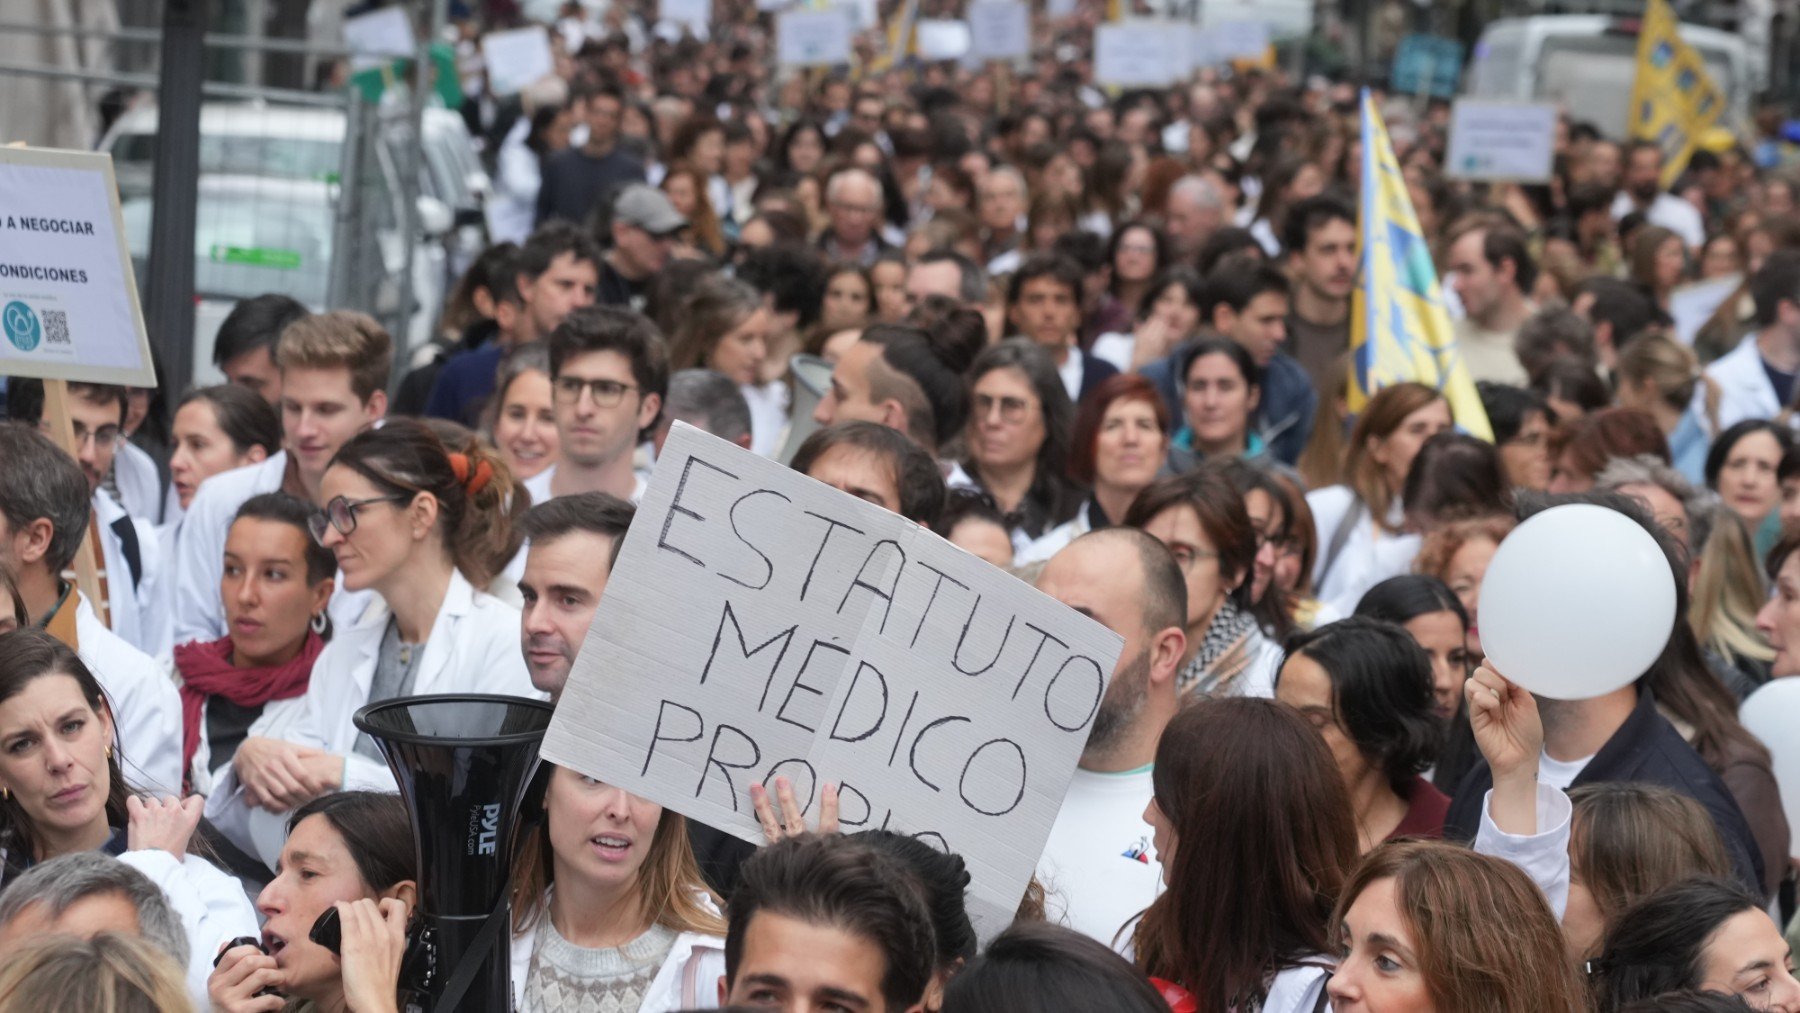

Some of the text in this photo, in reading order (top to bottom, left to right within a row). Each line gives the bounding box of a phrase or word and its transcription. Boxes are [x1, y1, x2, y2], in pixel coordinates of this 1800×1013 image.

[0, 263, 89, 284] ONDICIONES
[7, 215, 17, 230] A
[20, 216, 95, 236] NEGOCIAR
[658, 455, 1104, 732] ESTATUTO
[641, 699, 950, 854] PROP
[700, 600, 1026, 816] MÉDICO
